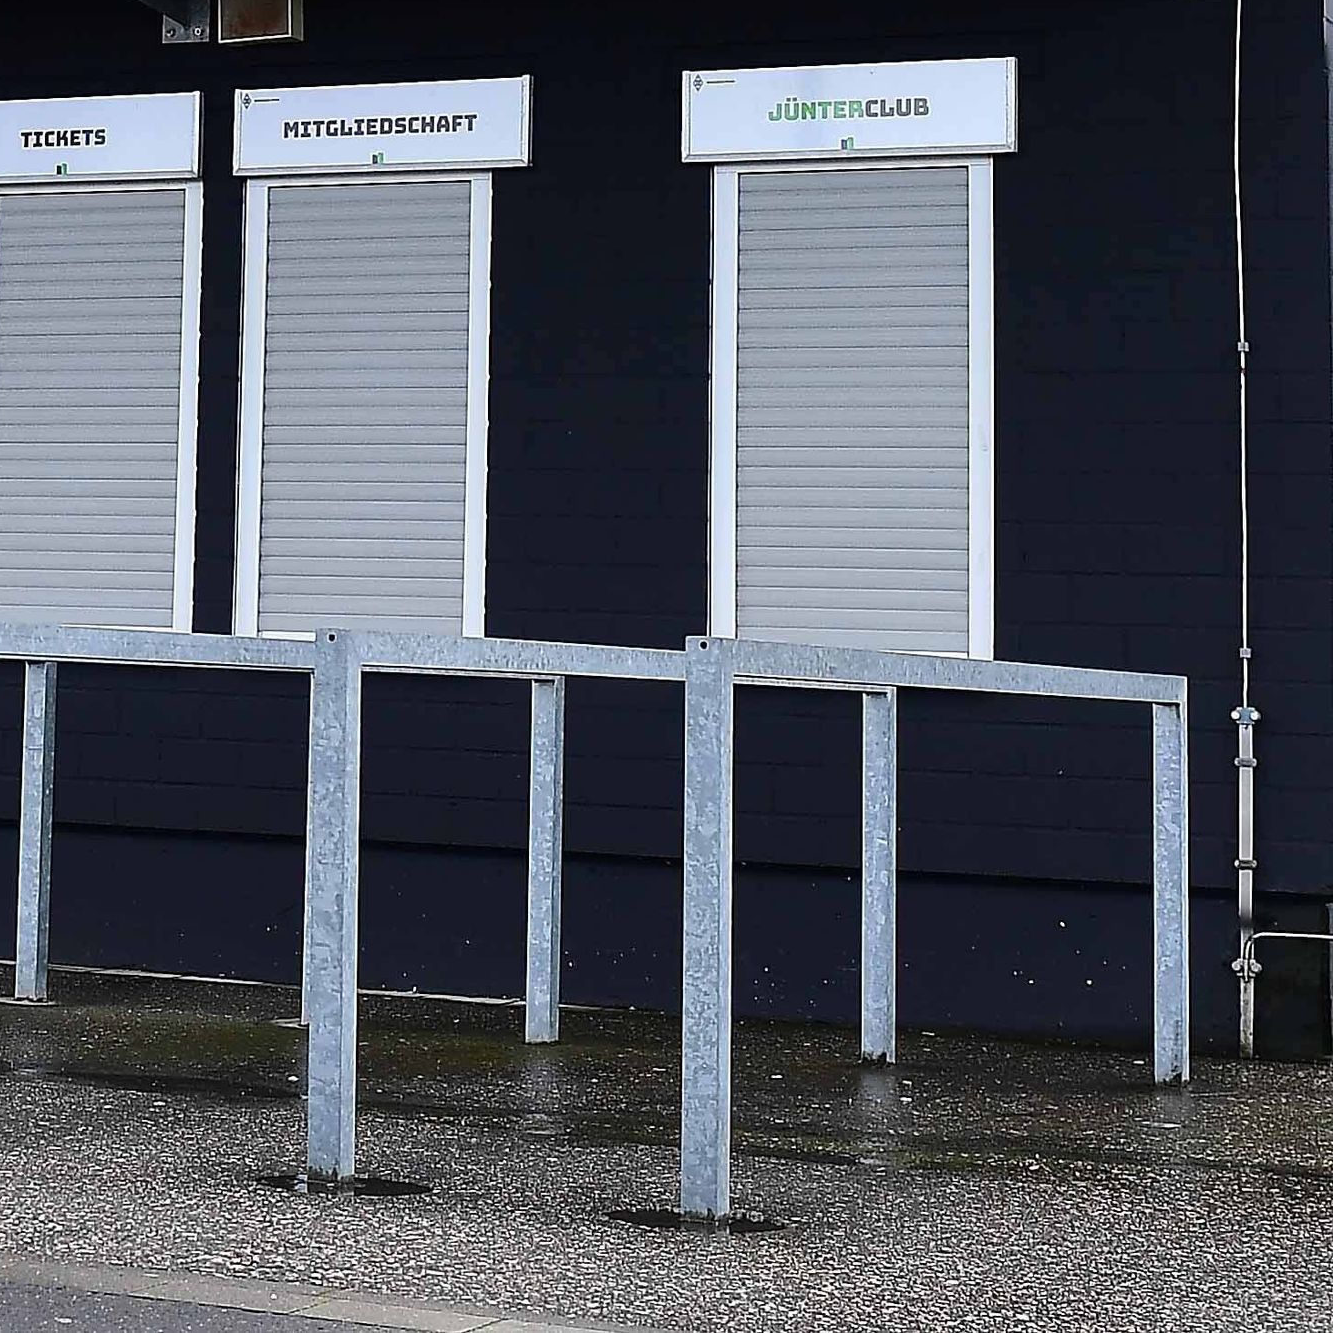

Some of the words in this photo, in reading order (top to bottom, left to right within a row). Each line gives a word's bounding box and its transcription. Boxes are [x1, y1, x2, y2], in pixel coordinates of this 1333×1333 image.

[767, 97, 930, 122] JÜNTERCLUB
[20, 128, 107, 148] TICKETS
[283, 114, 478, 139] MITGLIEDSCHAFT
